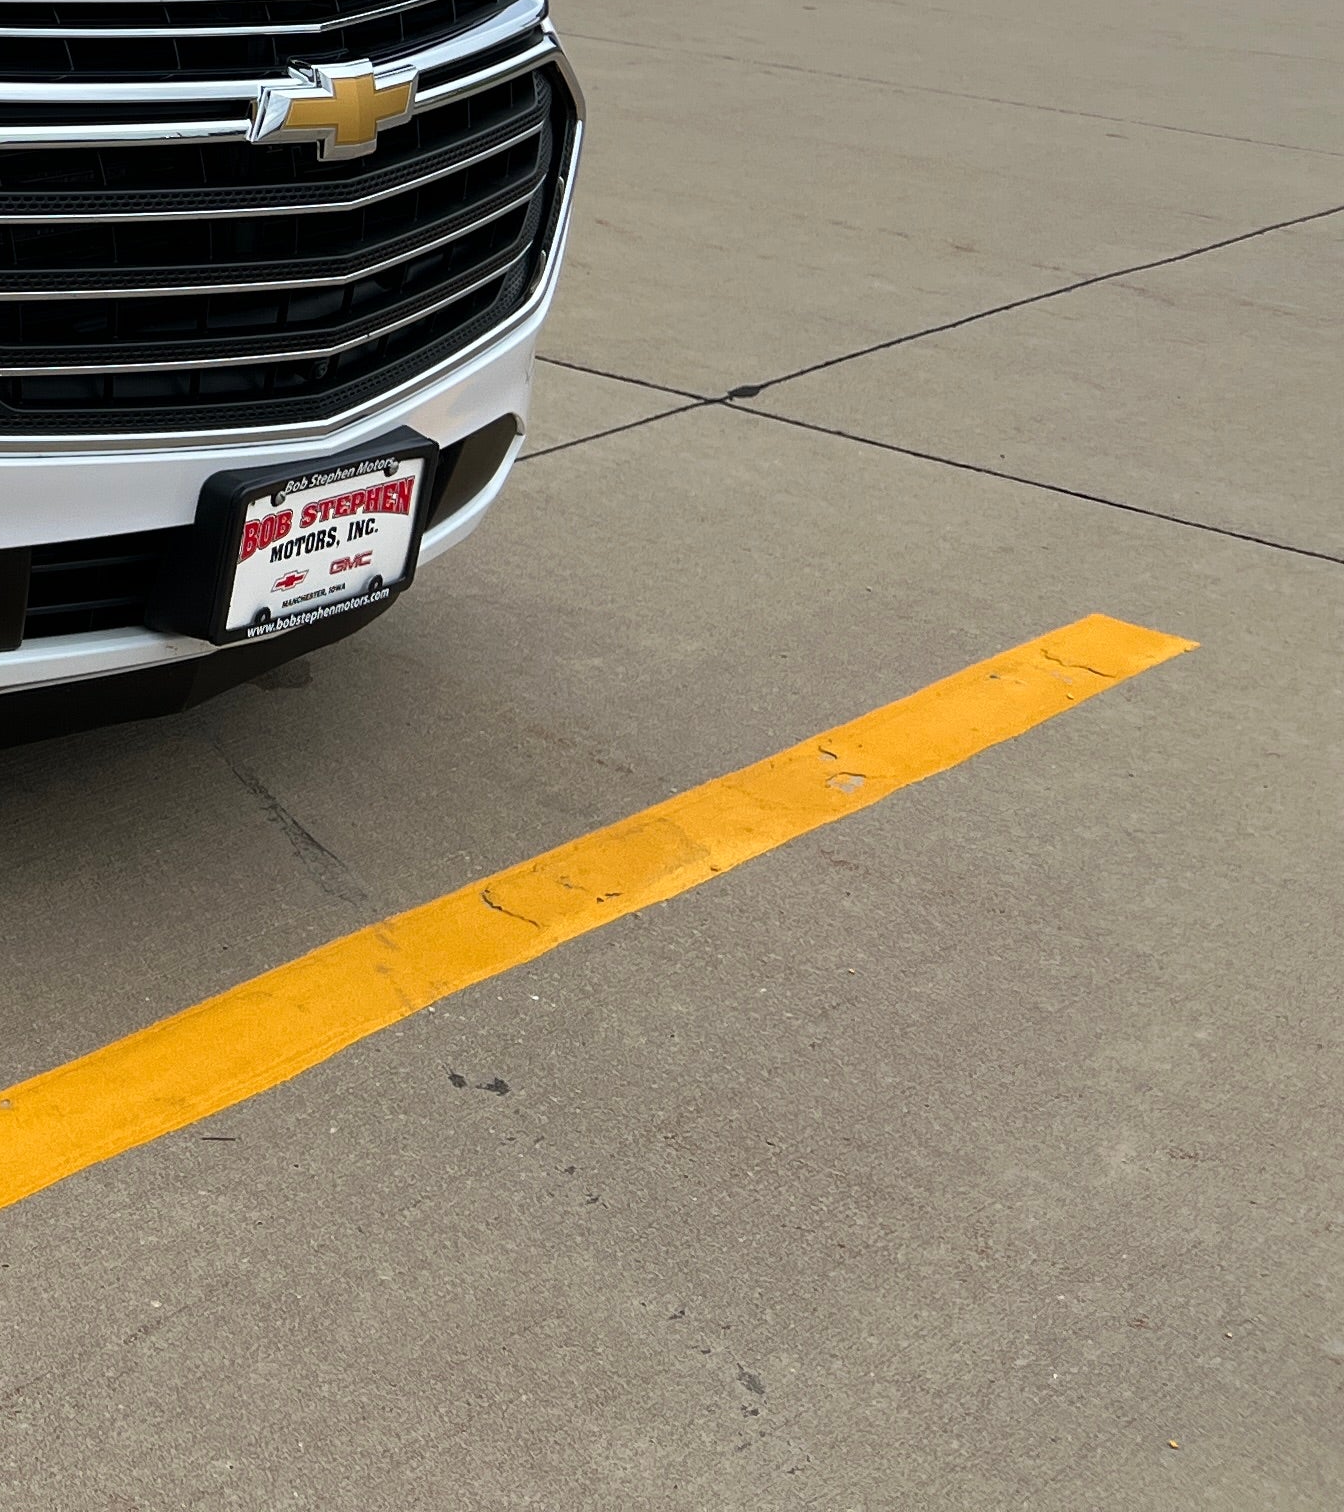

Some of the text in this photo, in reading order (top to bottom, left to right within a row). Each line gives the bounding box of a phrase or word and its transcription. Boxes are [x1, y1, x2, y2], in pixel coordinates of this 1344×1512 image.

[284, 456, 396, 494] Bob Stephen Motors
[239, 475, 416, 562] BOB STEPHEN
[269, 518, 379, 563] MOTORS, INC.
[329, 550, 373, 575] GMC
[328, 582, 346, 594] IOWA
[246, 587, 390, 638] www.bobstephenmotors.com
